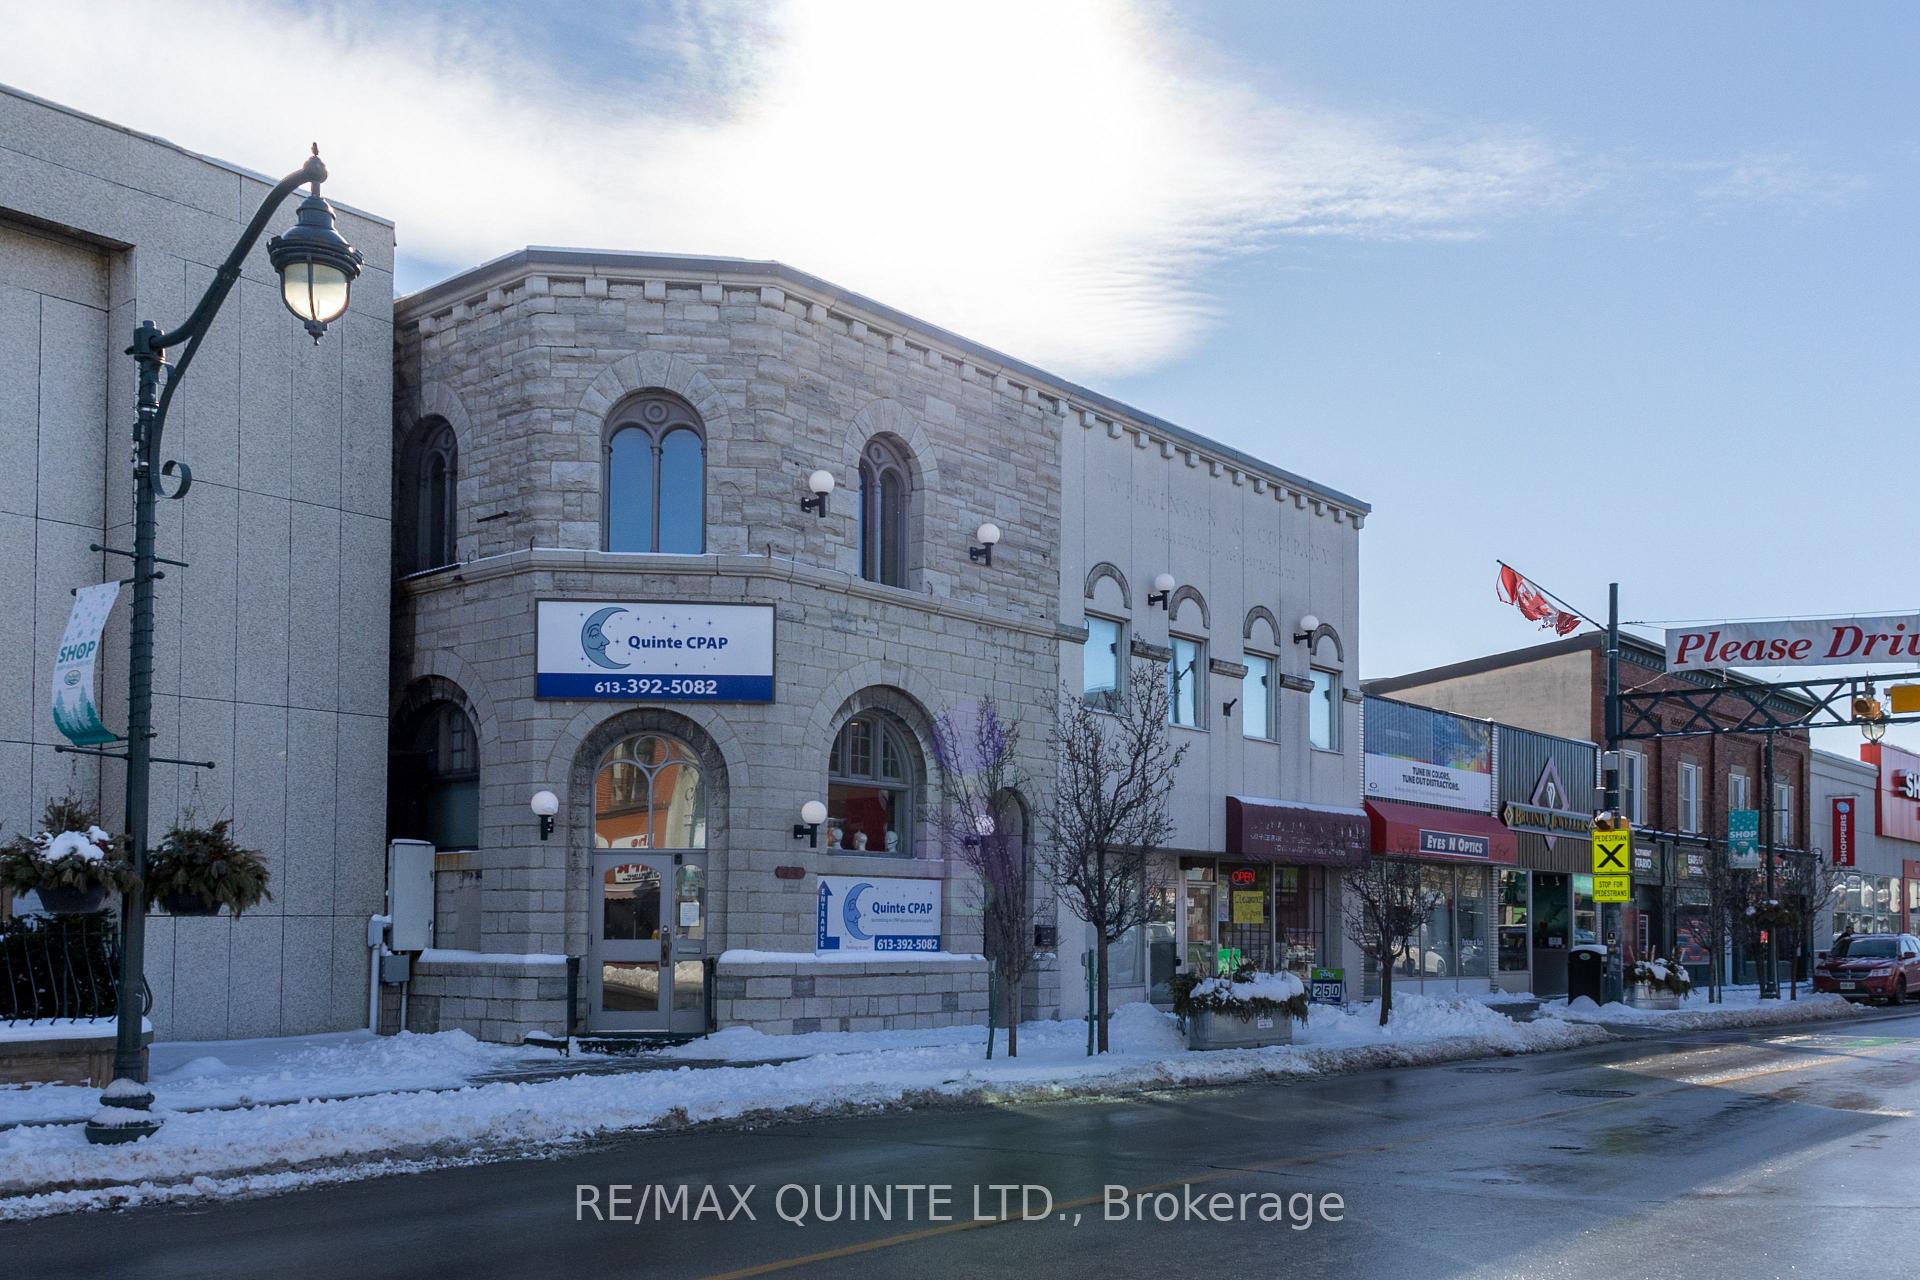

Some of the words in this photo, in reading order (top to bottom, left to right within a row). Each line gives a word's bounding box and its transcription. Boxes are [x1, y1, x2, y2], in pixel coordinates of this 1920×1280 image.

[628, 635, 682, 649] Quinte
[686, 636, 728, 649] CPAP
[1674, 630, 1813, 665] Please
[58, 640, 96, 663] SHOP
[594, 679, 717, 695] 613-392-5082
[1412, 767, 1426, 777] TUNE
[1402, 774, 1415, 784] TUNE
[1416, 776, 1426, 785] OUT
[1594, 834, 1627, 842] PEDESTRIAN
[1729, 830, 1757, 839] SHOP
[1840, 814, 1848, 863] SHOPPERS
[1427, 835, 1446, 850] EYES
[1448, 837, 1456, 851] N
[1458, 838, 1483, 854] OPTICS
[1231, 871, 1254, 881] OPEN
[872, 902, 905, 914] Quinte
[908, 903, 933, 914] CPAP
[877, 938, 938, 950] 613-392-5082
